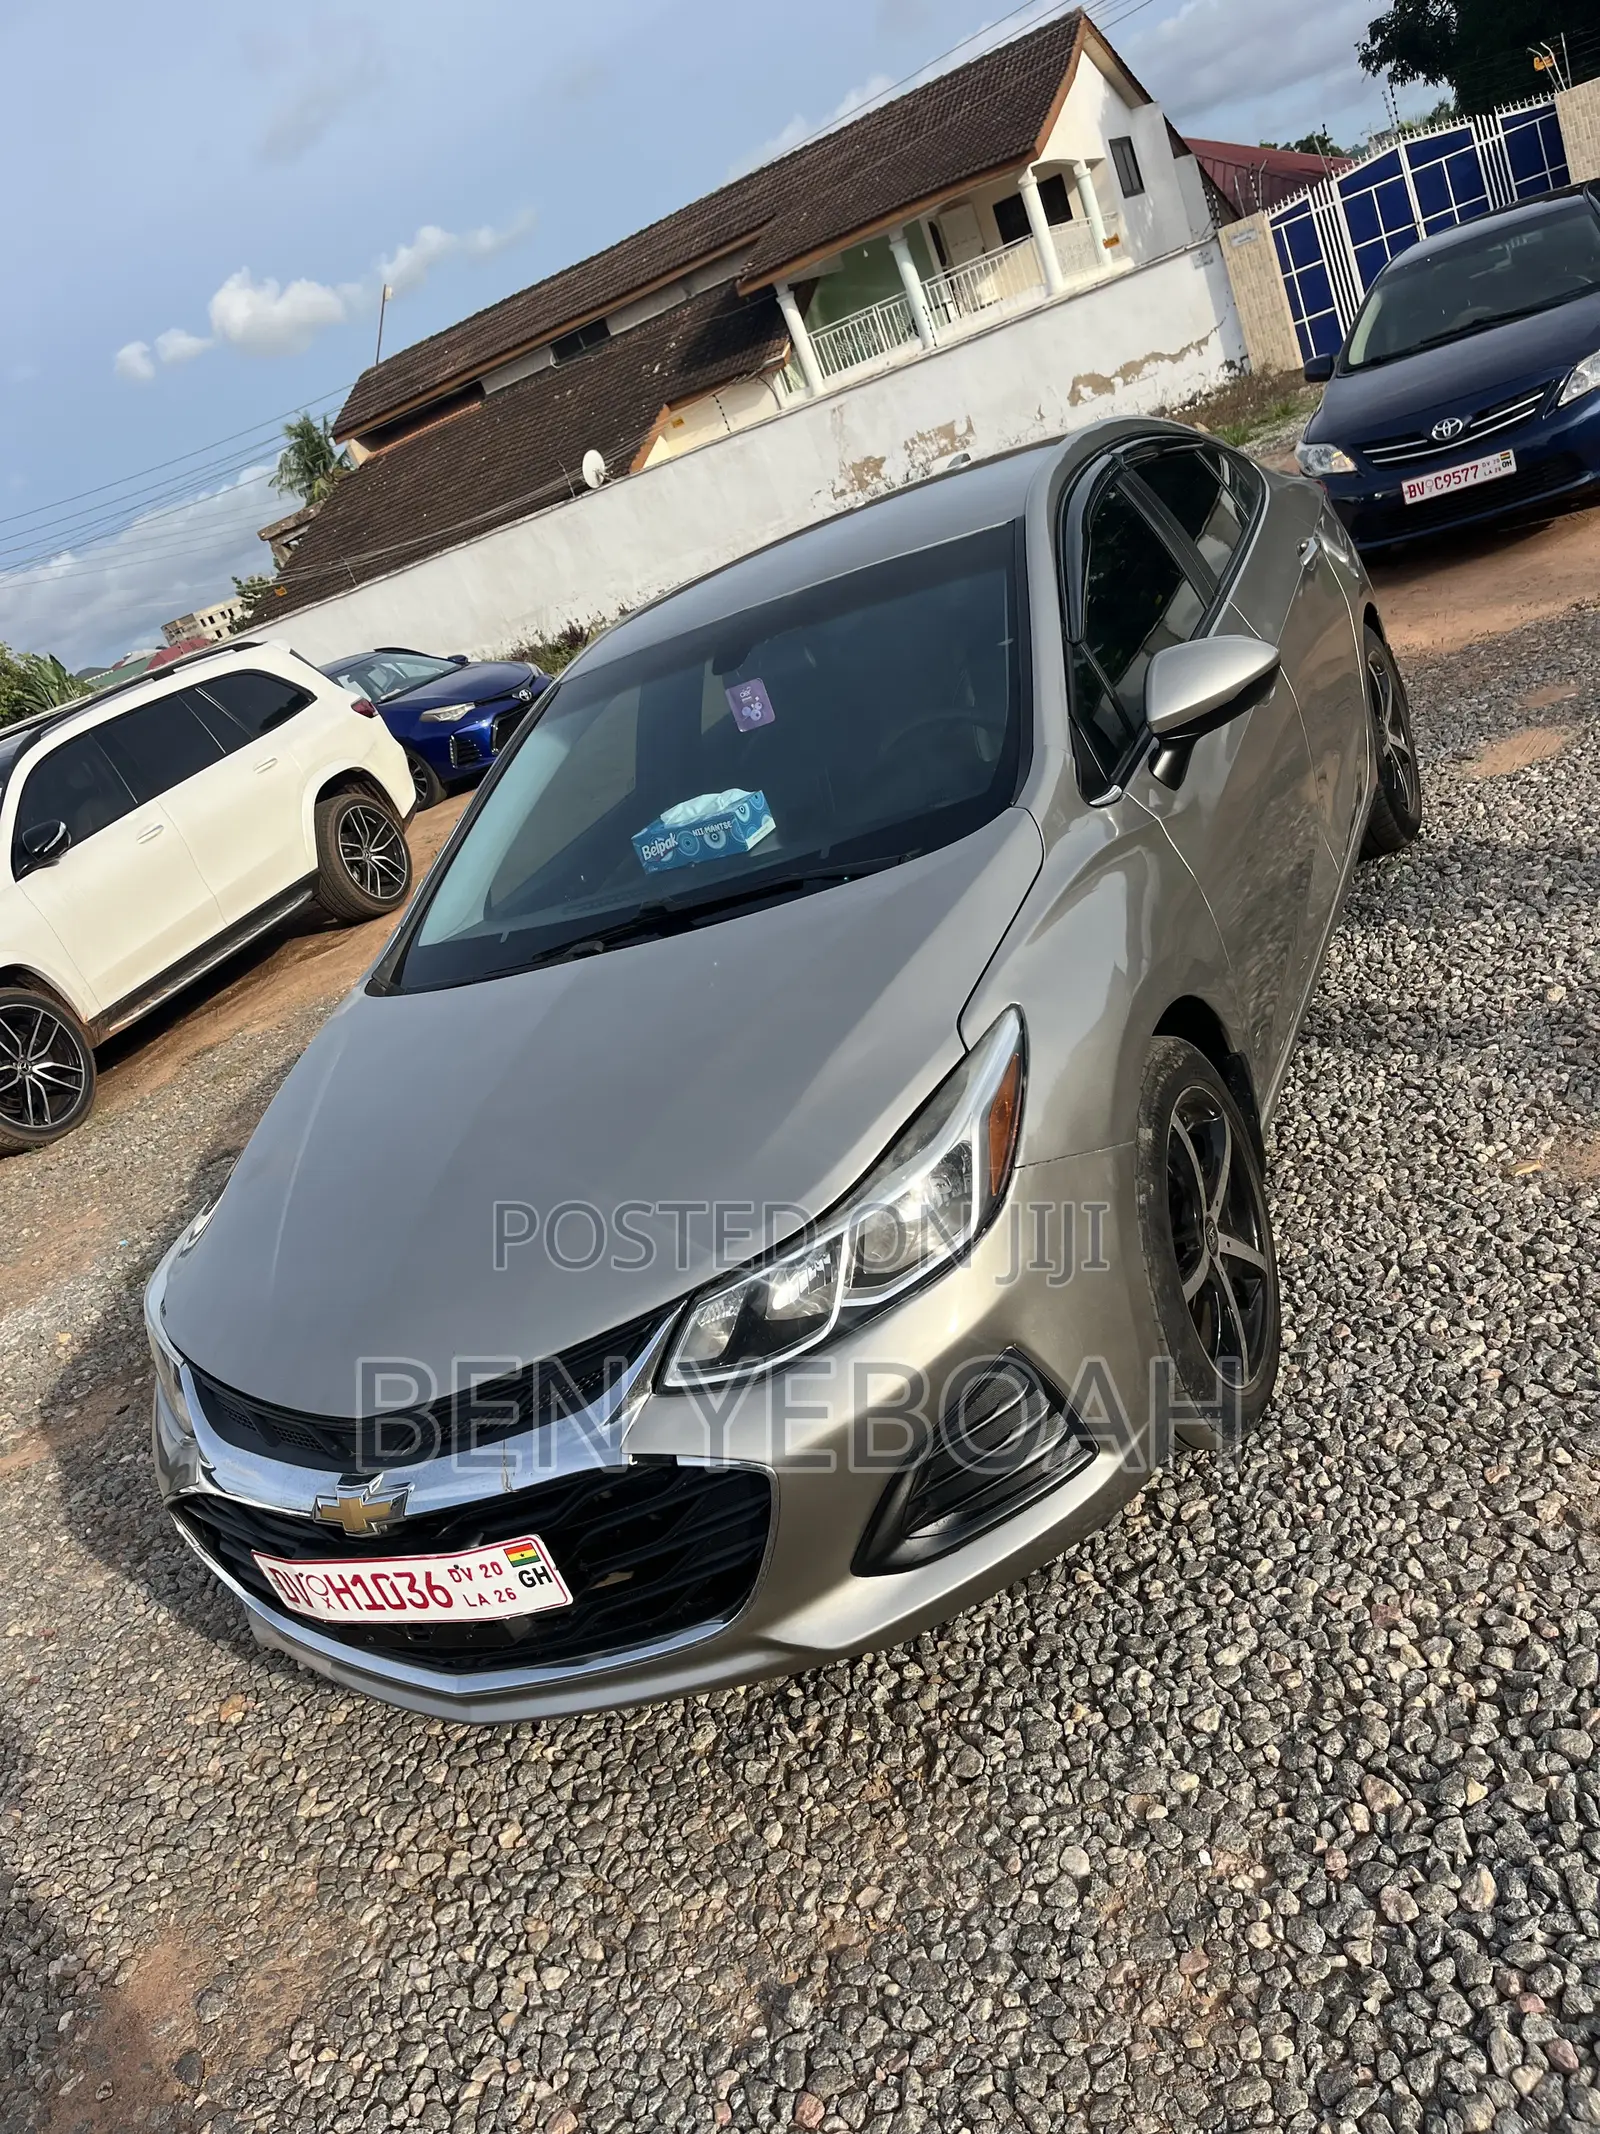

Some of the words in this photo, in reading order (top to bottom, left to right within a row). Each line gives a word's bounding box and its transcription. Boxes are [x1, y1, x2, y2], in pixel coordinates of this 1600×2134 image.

[1407, 481, 1425, 498] BV
[1434, 465, 1479, 490] C9577
[705, 820, 733, 834] MANTSE
[641, 832, 679, 861] Belpak
[447, 1567, 473, 1583] DV
[479, 1561, 503, 1578] 20
[518, 1565, 553, 1588] GH
[462, 1592, 492, 1607] LA
[493, 1587, 517, 1603] 26
